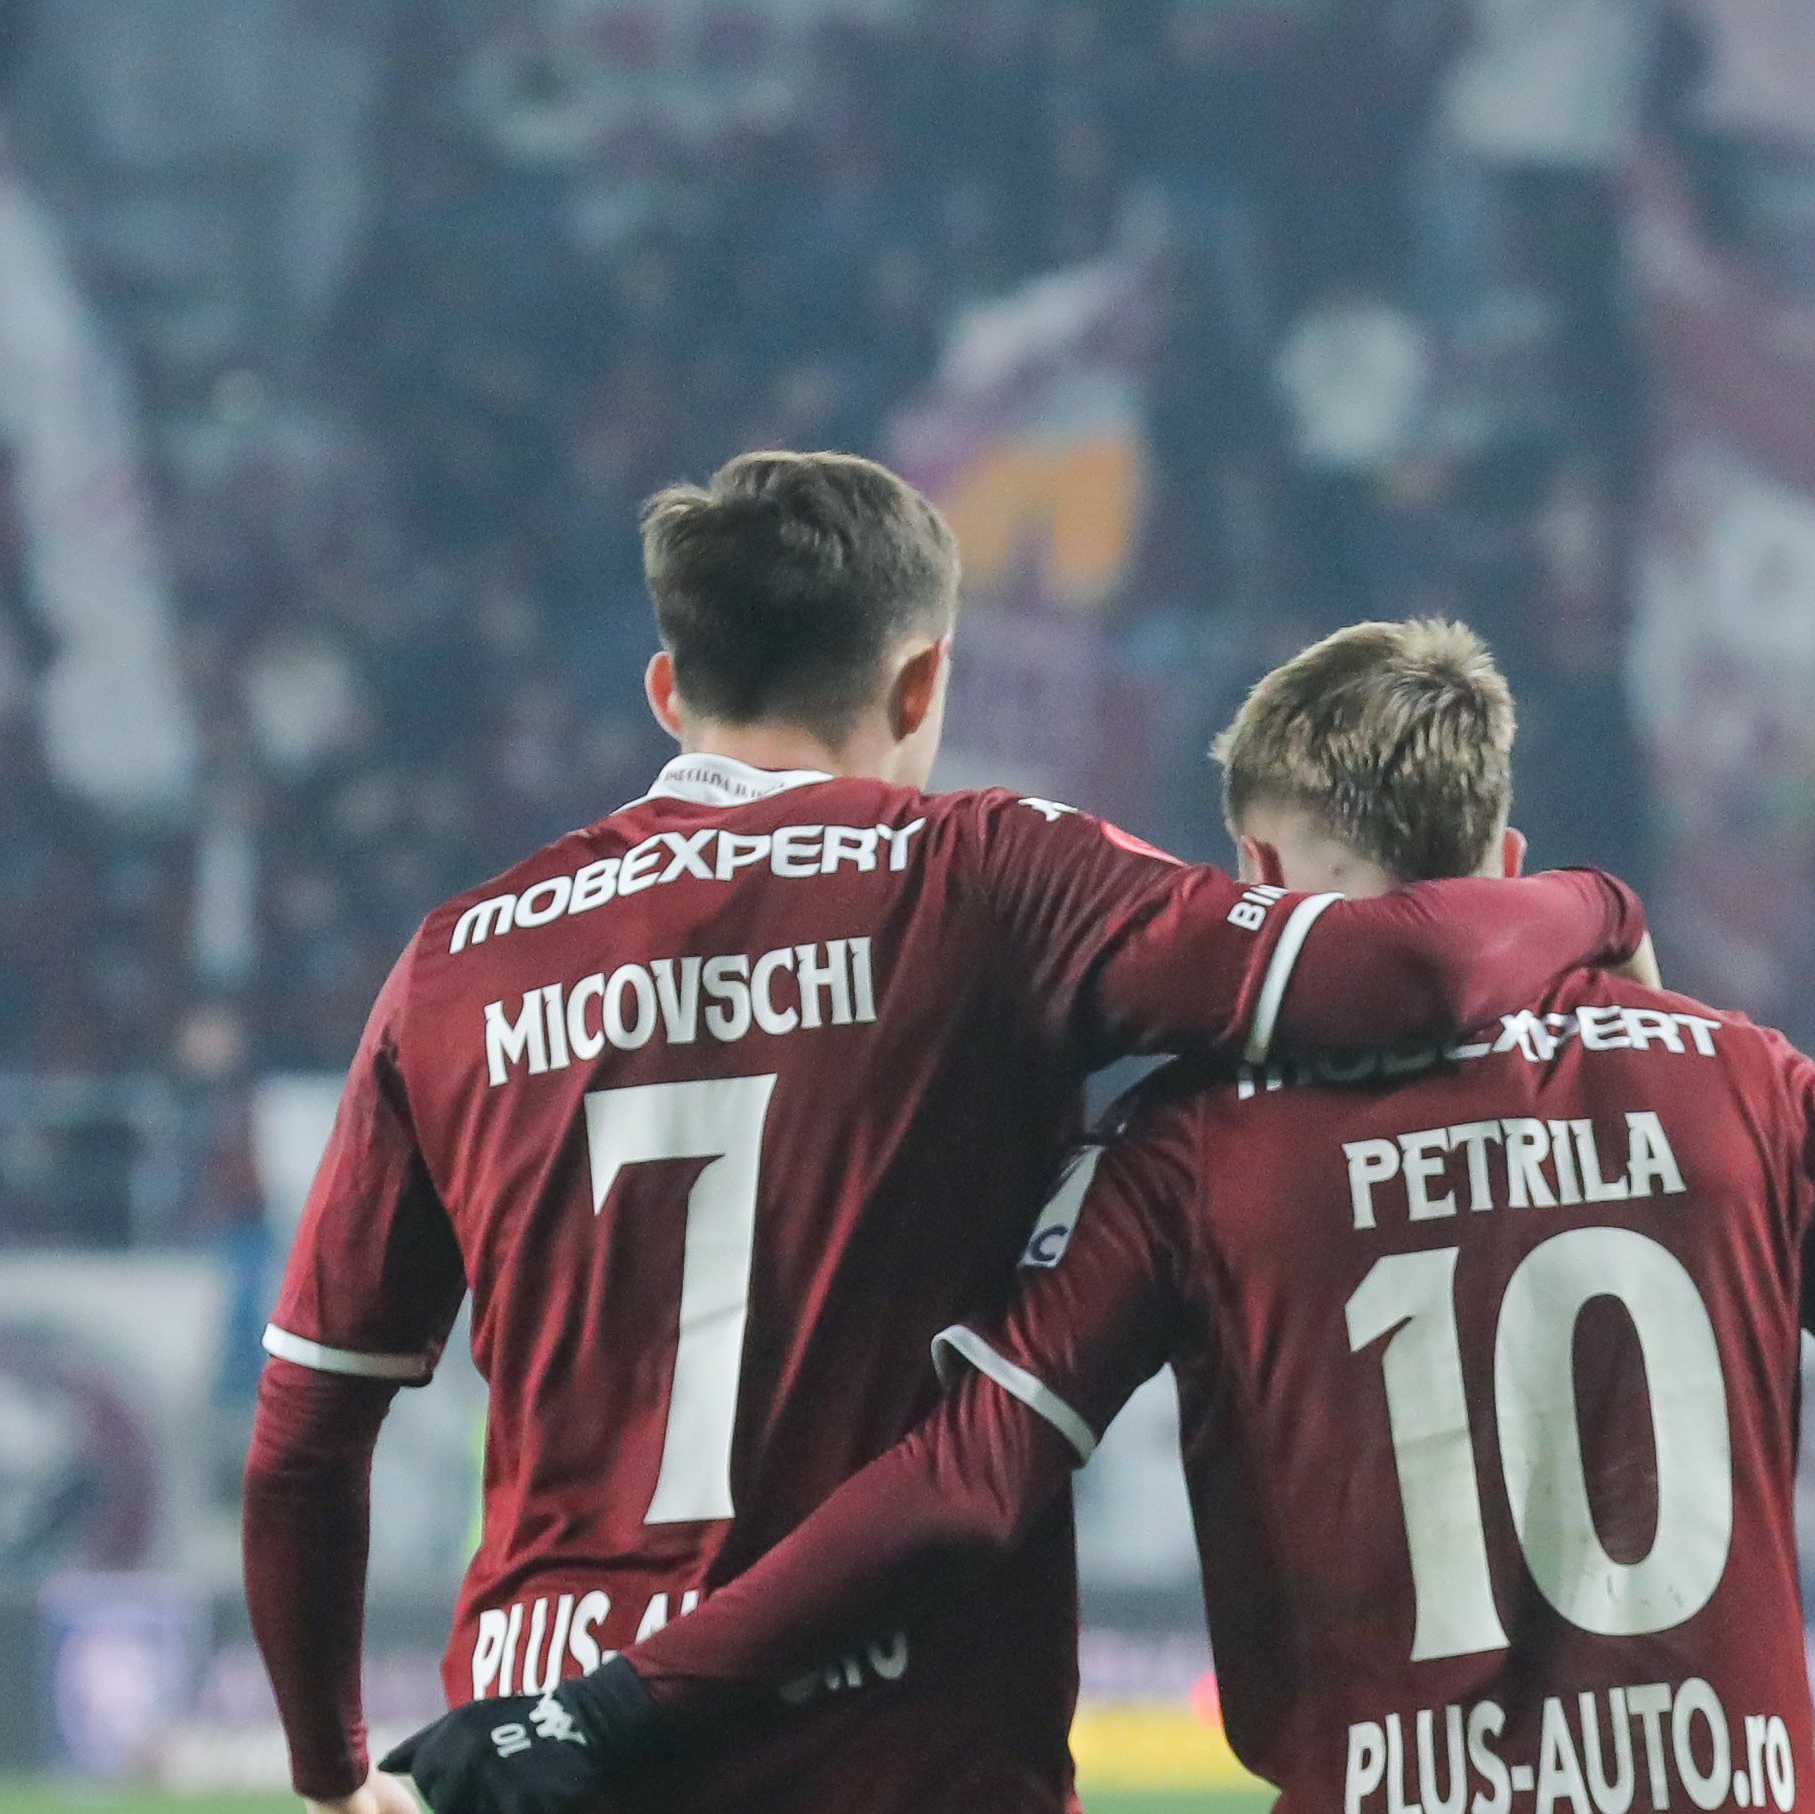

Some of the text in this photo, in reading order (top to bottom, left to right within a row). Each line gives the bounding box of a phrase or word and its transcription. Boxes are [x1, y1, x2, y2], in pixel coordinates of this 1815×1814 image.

[483, 936, 877, 1088] MICOVSCHI
[585, 1073, 778, 1525] 7
[1342, 1111, 1686, 1231] PETRILA
[1345, 1226, 1733, 1662] 10
